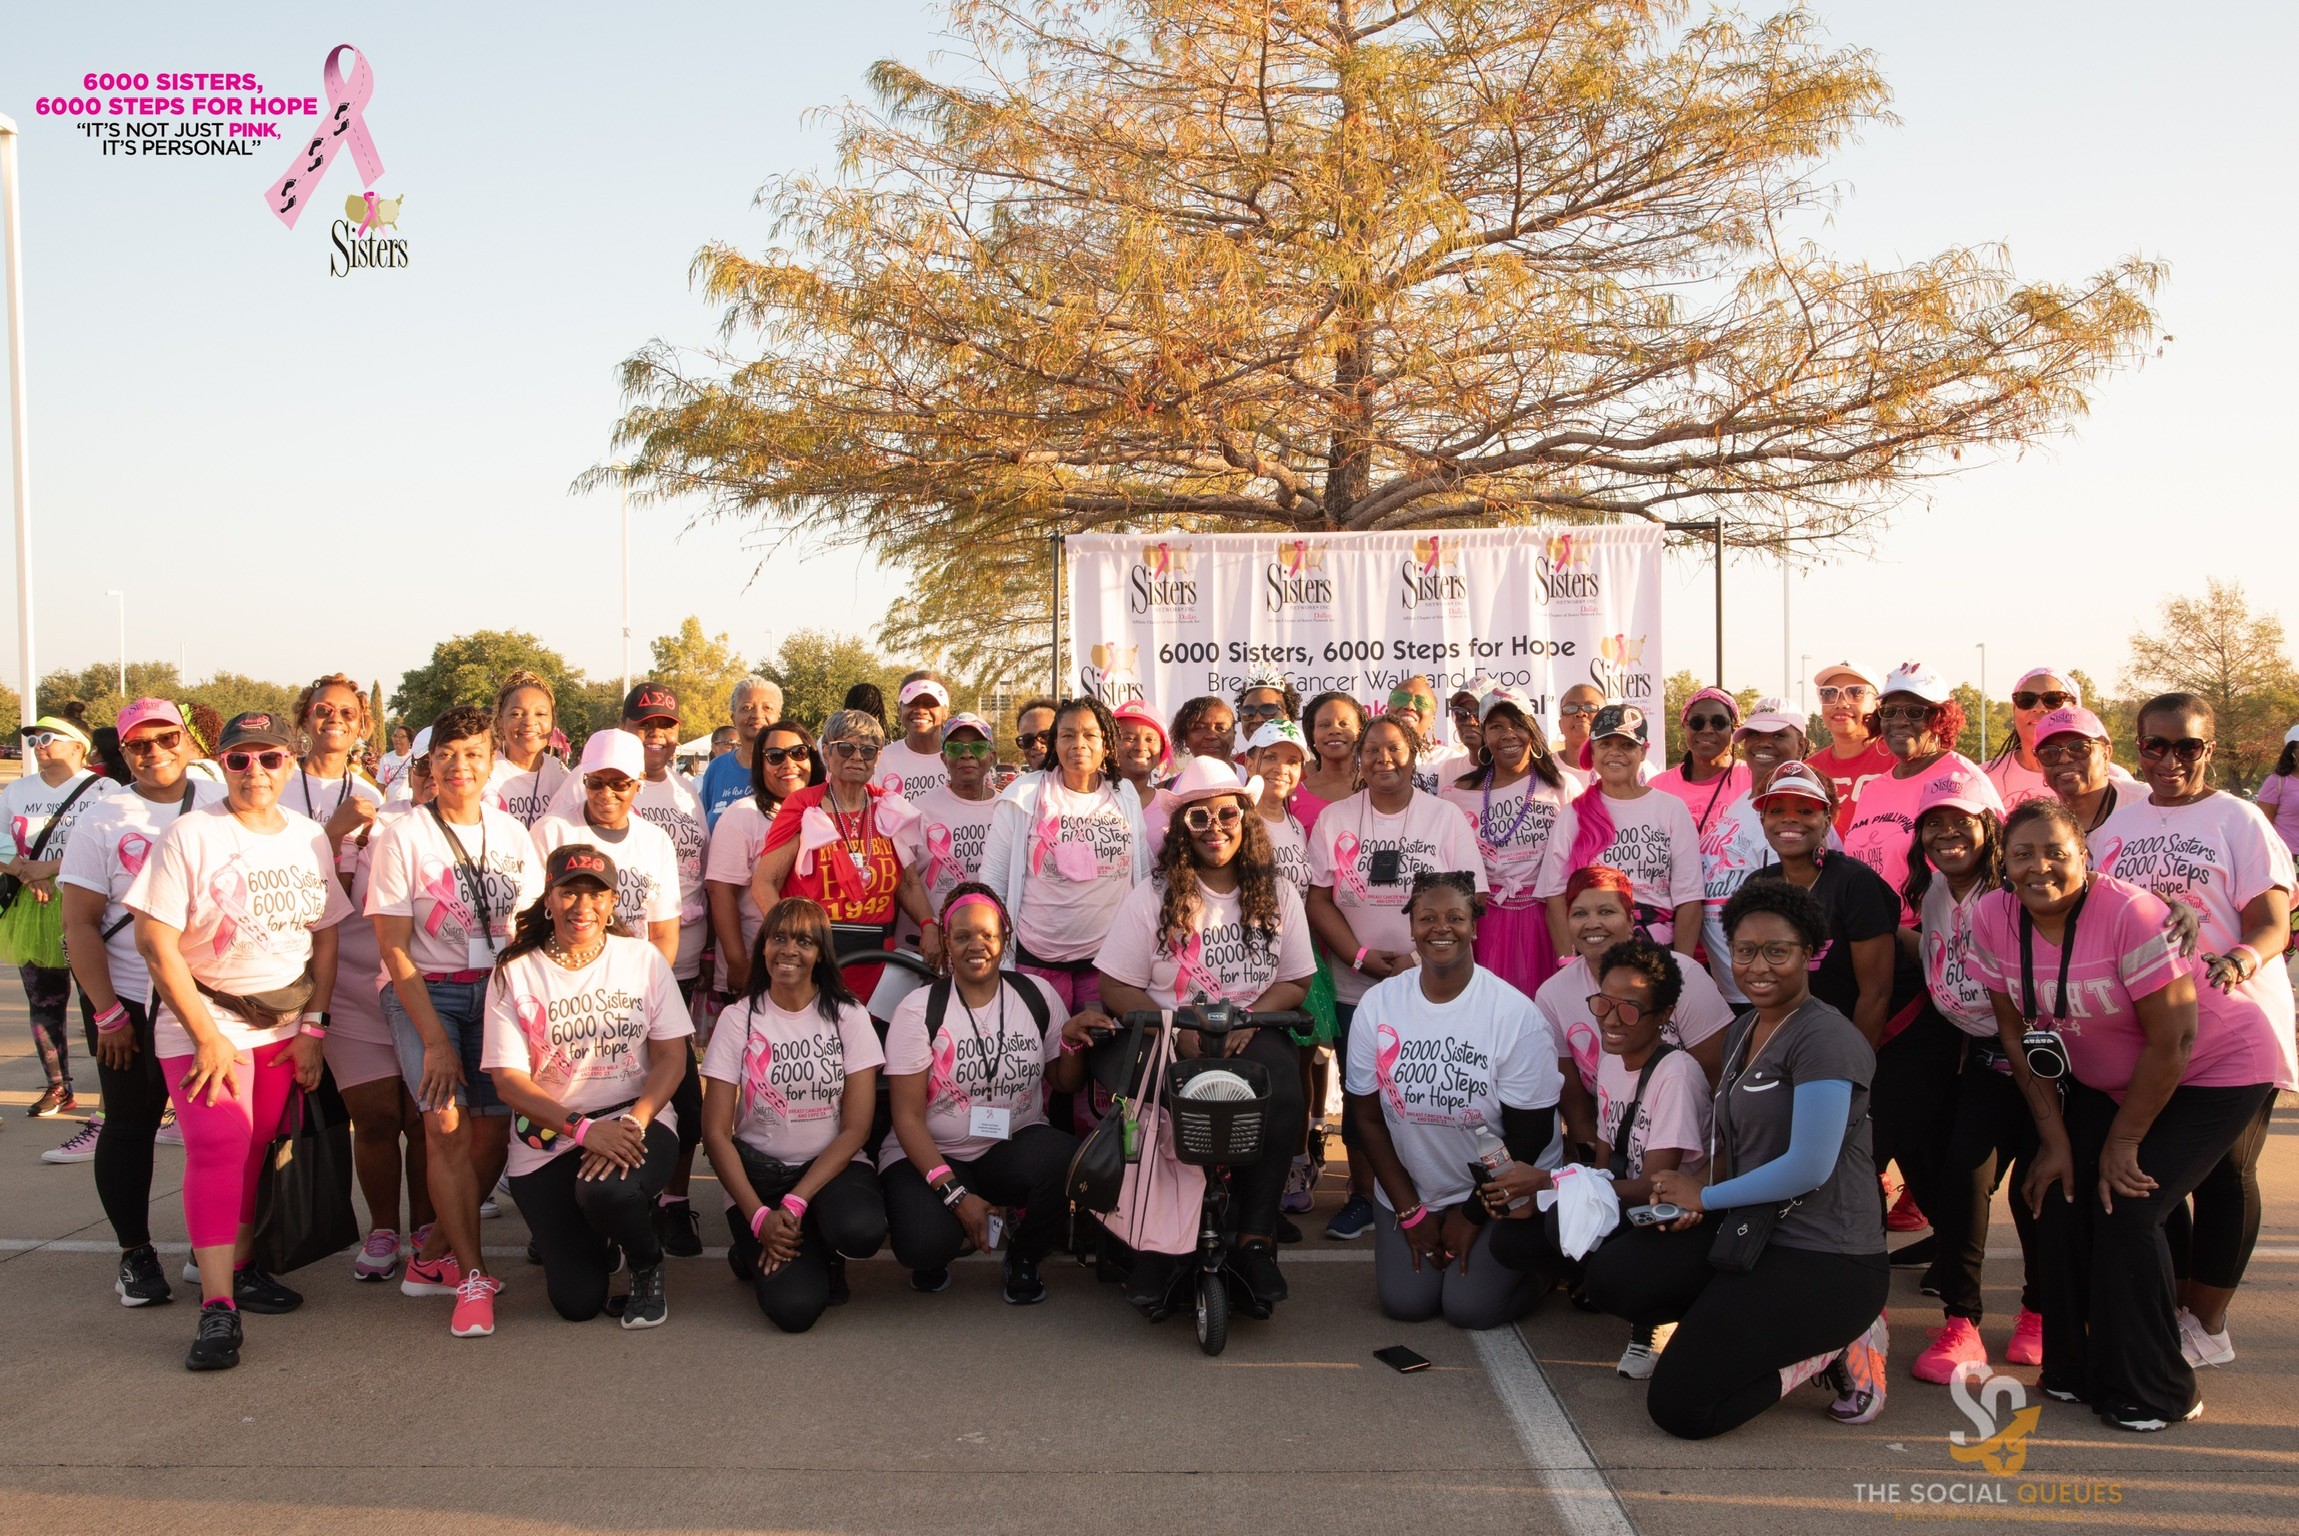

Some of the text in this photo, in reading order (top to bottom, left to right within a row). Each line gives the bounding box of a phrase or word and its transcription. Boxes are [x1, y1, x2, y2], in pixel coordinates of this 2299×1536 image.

[1131, 564, 1197, 615] Sisters
[1266, 563, 1332, 613] Sisters
[1401, 560, 1466, 610] Sisters
[1535, 555, 1599, 606] Sisters
[1159, 635, 1576, 666] 6000 Sisters, 6000 Steps for Hope
[1425, 667, 1466, 688] and
[637, 691, 676, 711] ΔΣΘ
[904, 775, 936, 791] 6000
[24, 803, 43, 814] MY
[509, 796, 540, 814] 6000
[641, 807, 671, 822] 6000
[952, 824, 985, 842] 6000
[1515, 829, 1549, 849] Hope.
[1613, 827, 1639, 846] 000
[1603, 844, 1641, 864] 6000
[1867, 846, 1884, 861] ONE
[2120, 833, 2216, 864] 6000 Sisters,
[565, 855, 605, 872] ΔΣΘ
[965, 857, 981, 873] for
[1399, 854, 1435, 874] Steps
[1637, 860, 1667, 884] Hope.
[2114, 852, 2210, 890] 6000 Steps
[248, 868, 290, 893] 6000
[253, 890, 296, 917] 6000
[827, 895, 891, 921] 1942
[267, 914, 287, 932] for
[1202, 923, 1240, 946] 6000
[1205, 943, 1246, 968] 6000
[1219, 965, 1240, 984] for
[1959, 982, 1979, 1003] for
[2004, 976, 2123, 1018] FGHT
[548, 993, 592, 1022] 6000
[551, 1010, 644, 1046] 6000 Steps
[569, 1042, 590, 1060] for
[772, 1039, 811, 1063] 6000
[956, 1035, 995, 1061] 6000
[1400, 1039, 1441, 1061] 6000
[771, 1060, 814, 1085] 6000
[956, 1054, 1041, 1087] 6000 Steps
[785, 1084, 807, 1101] for
[969, 1077, 1027, 1101] for Hope.
[1394, 1062, 1488, 1104] 6000 Steps
[1404, 1084, 1469, 1115] for Hope.
